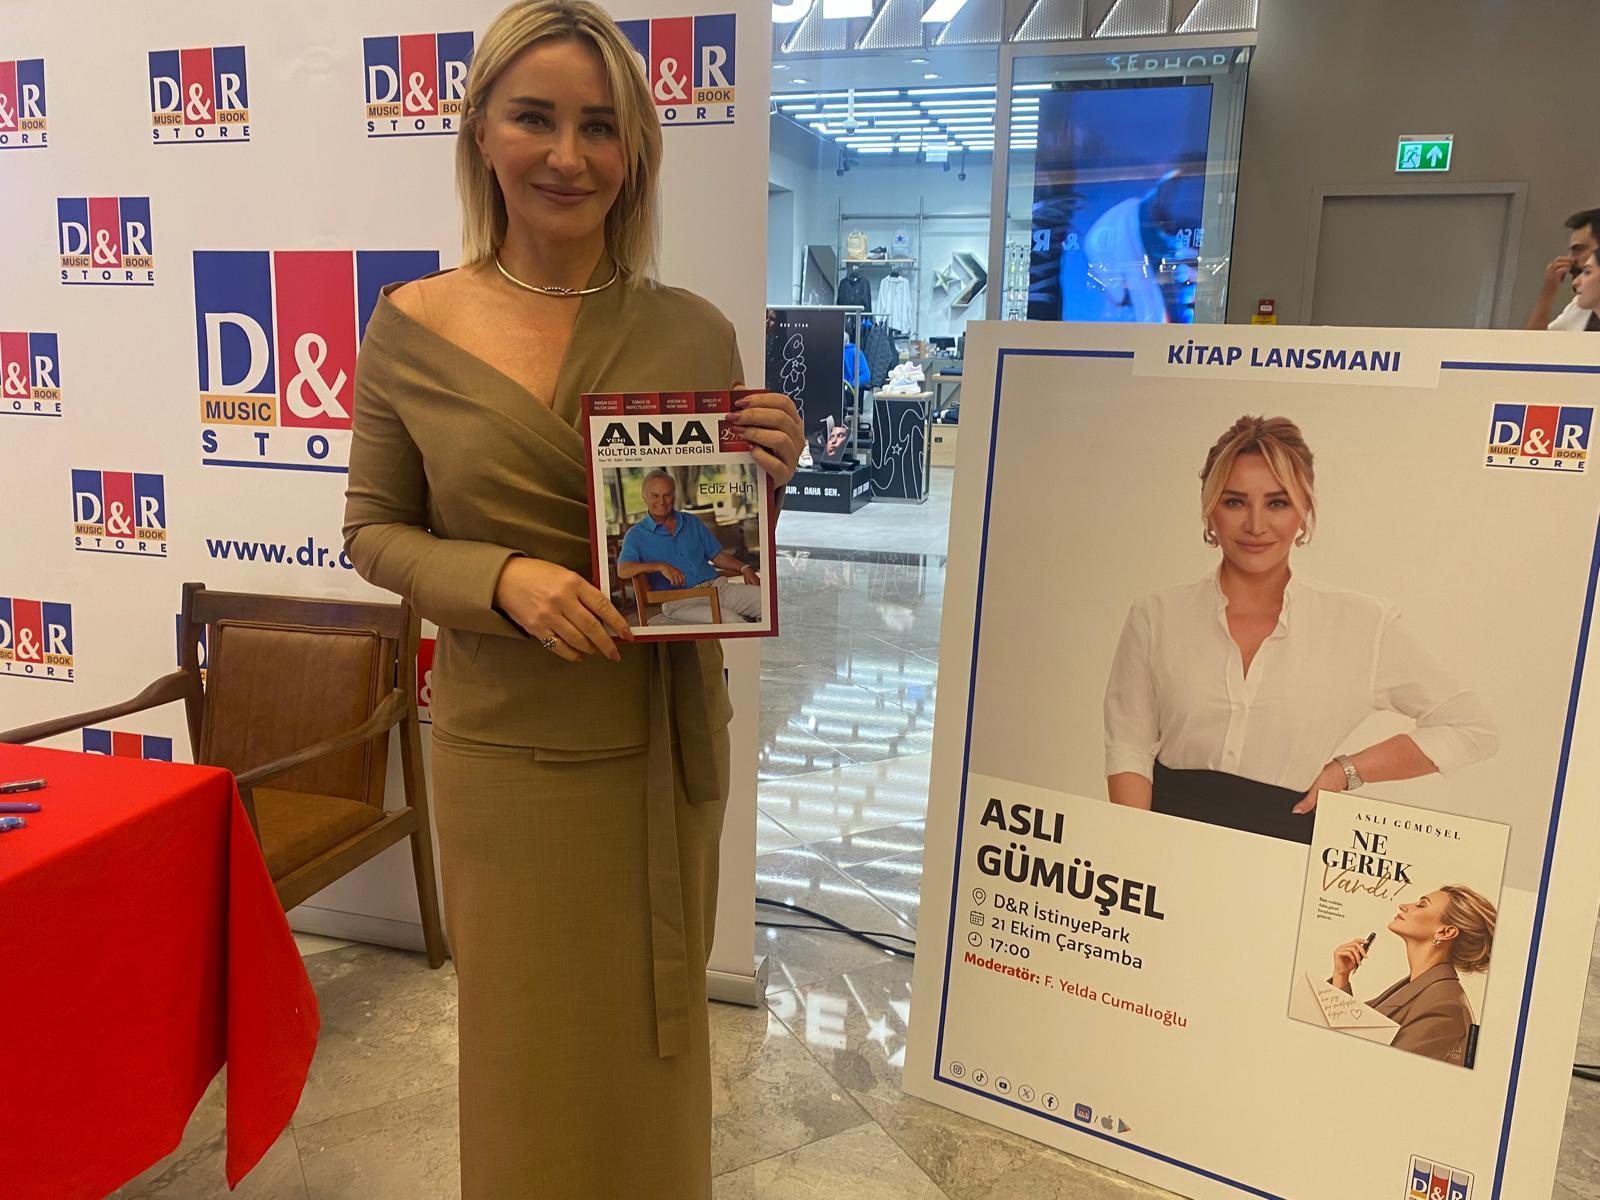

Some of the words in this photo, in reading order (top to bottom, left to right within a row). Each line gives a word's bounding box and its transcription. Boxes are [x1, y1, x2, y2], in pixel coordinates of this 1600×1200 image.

[153, 73, 246, 121] D&R
[368, 61, 466, 113] D&R
[698, 90, 730, 101] BOOK
[154, 115, 181, 125] MUSIC
[220, 112, 246, 122] BOOK
[368, 106, 400, 116] MUSIC
[21, 121, 44, 130] BOOK
[153, 126, 250, 139] STORE
[62, 221, 149, 265] D&R
[62, 258, 89, 267] MUSIC
[126, 258, 150, 267] BOOK
[61, 270, 154, 281] STORE
[1167, 339, 1242, 366] KİTAP
[1250, 347, 1401, 372] LANSMANI
[34, 389, 58, 399] BOOK
[206, 400, 272, 421] MUSIC
[598, 420, 713, 447] ANA
[1491, 421, 1584, 455] D&R
[597, 447, 637, 457] KÜLTÜR
[640, 447, 673, 456] SANAT
[675, 444, 715, 455] DERGİSİ
[1489, 446, 1518, 455] MUSIC
[1556, 450, 1584, 459] BOOK
[1486, 455, 1585, 469] STORE
[700, 483, 725, 494] Ediz
[729, 482, 754, 493] Hun
[76, 492, 162, 535] D&R
[76, 525, 103, 535] MUSIC
[139, 530, 164, 540] BOOK
[75, 536, 167, 553] STORE
[47, 655, 71, 666] BOOK
[980, 798, 1065, 844] ASLI
[1355, 812, 1387, 825] ASLI
[1394, 819, 1461, 840] GÜMÜŞEL
[1351, 829, 1388, 856] NE
[1322, 847, 1413, 884] GEREK
[977, 842, 1165, 920] GÜMÜŞEL
[994, 894, 1029, 916] D&R
[1033, 901, 1130, 944] İstinyePark
[990, 938, 1030, 959] 17:00
[991, 917, 1005, 931] 21
[1011, 921, 1051, 944] Ekim
[1056, 933, 1143, 969] Çarşamba
[964, 951, 1040, 984] Moderatör:
[1044, 975, 1054, 988] F.
[1059, 978, 1097, 1001] Yelda
[1101, 992, 1187, 1028] Cumalıoğlu
